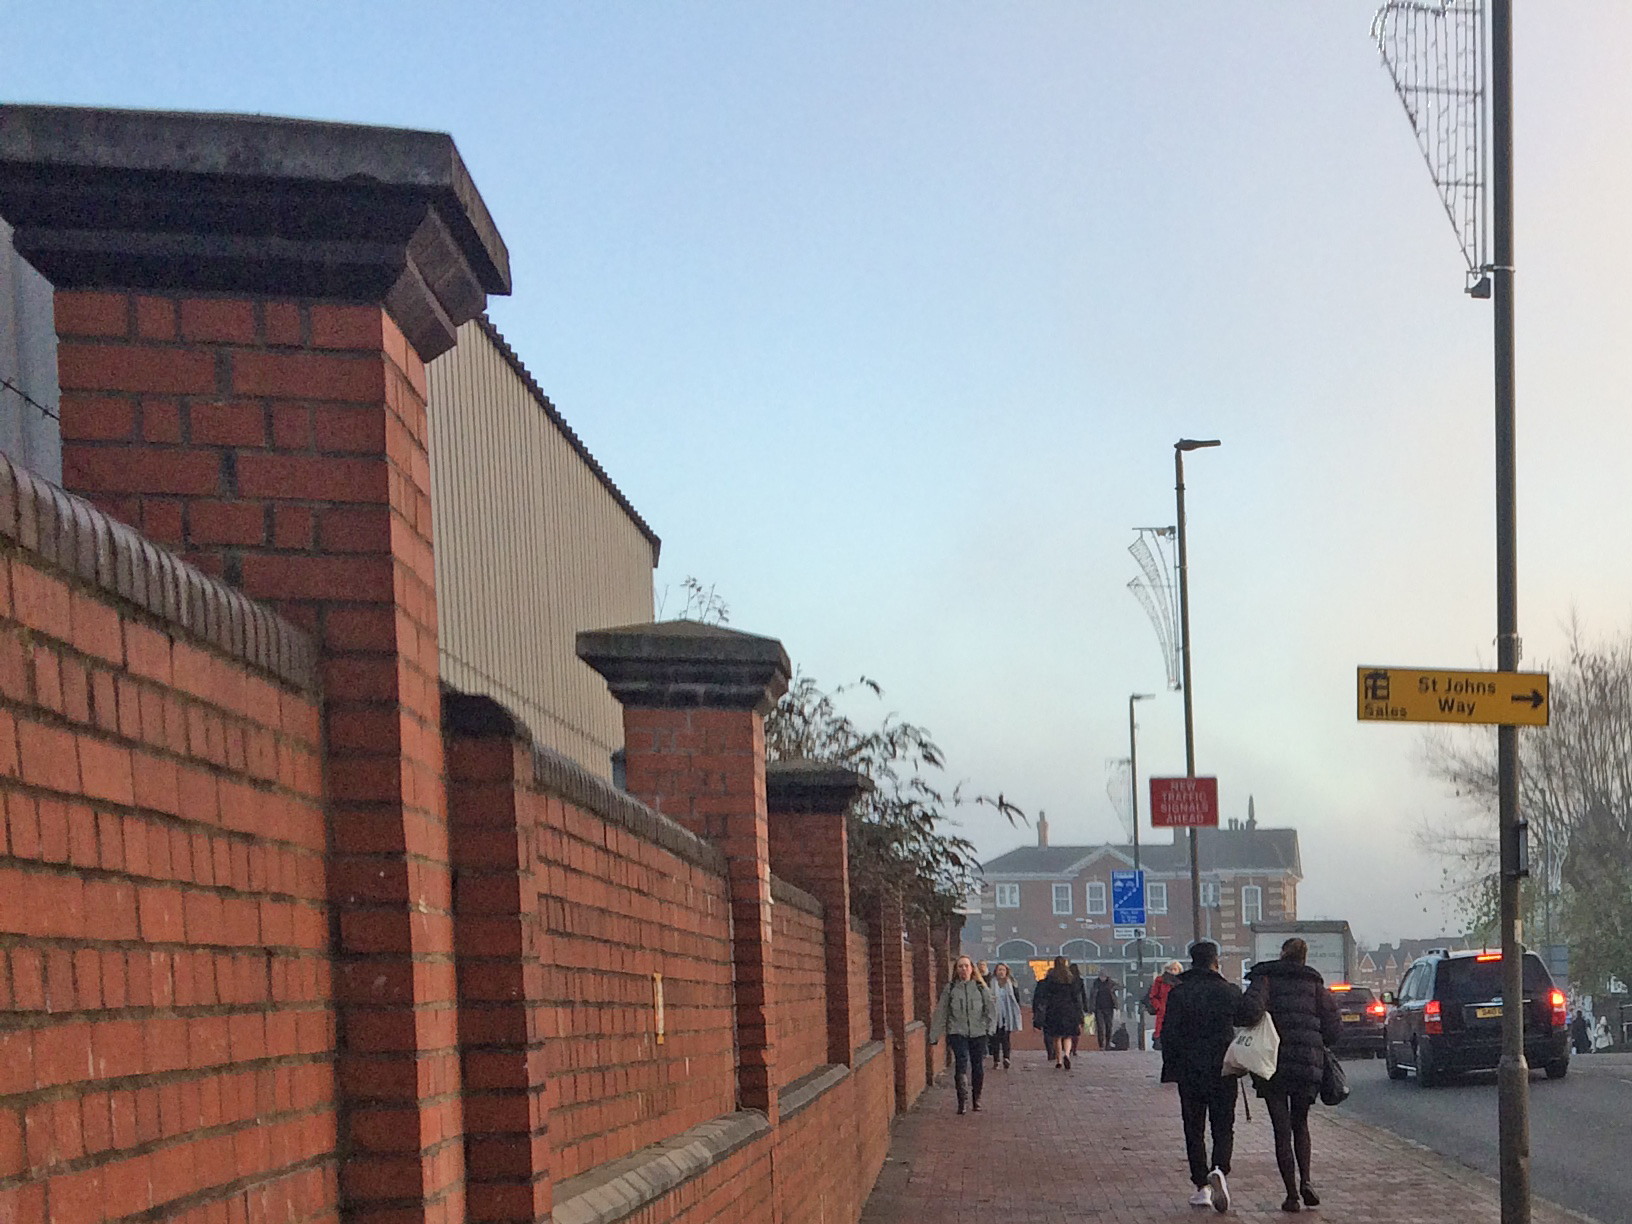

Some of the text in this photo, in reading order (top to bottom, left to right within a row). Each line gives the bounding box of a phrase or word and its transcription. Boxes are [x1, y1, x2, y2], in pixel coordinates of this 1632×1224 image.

[1418, 676, 1496, 695] St Johns
[1364, 702, 1407, 717] Sales
[1438, 697, 1475, 716] Way
[1170, 780, 1196, 791] NEW
[1162, 791, 1206, 802] TRAFFIC
[1160, 802, 1209, 813] SIGNALS
[1167, 813, 1204, 824] AHEAD
